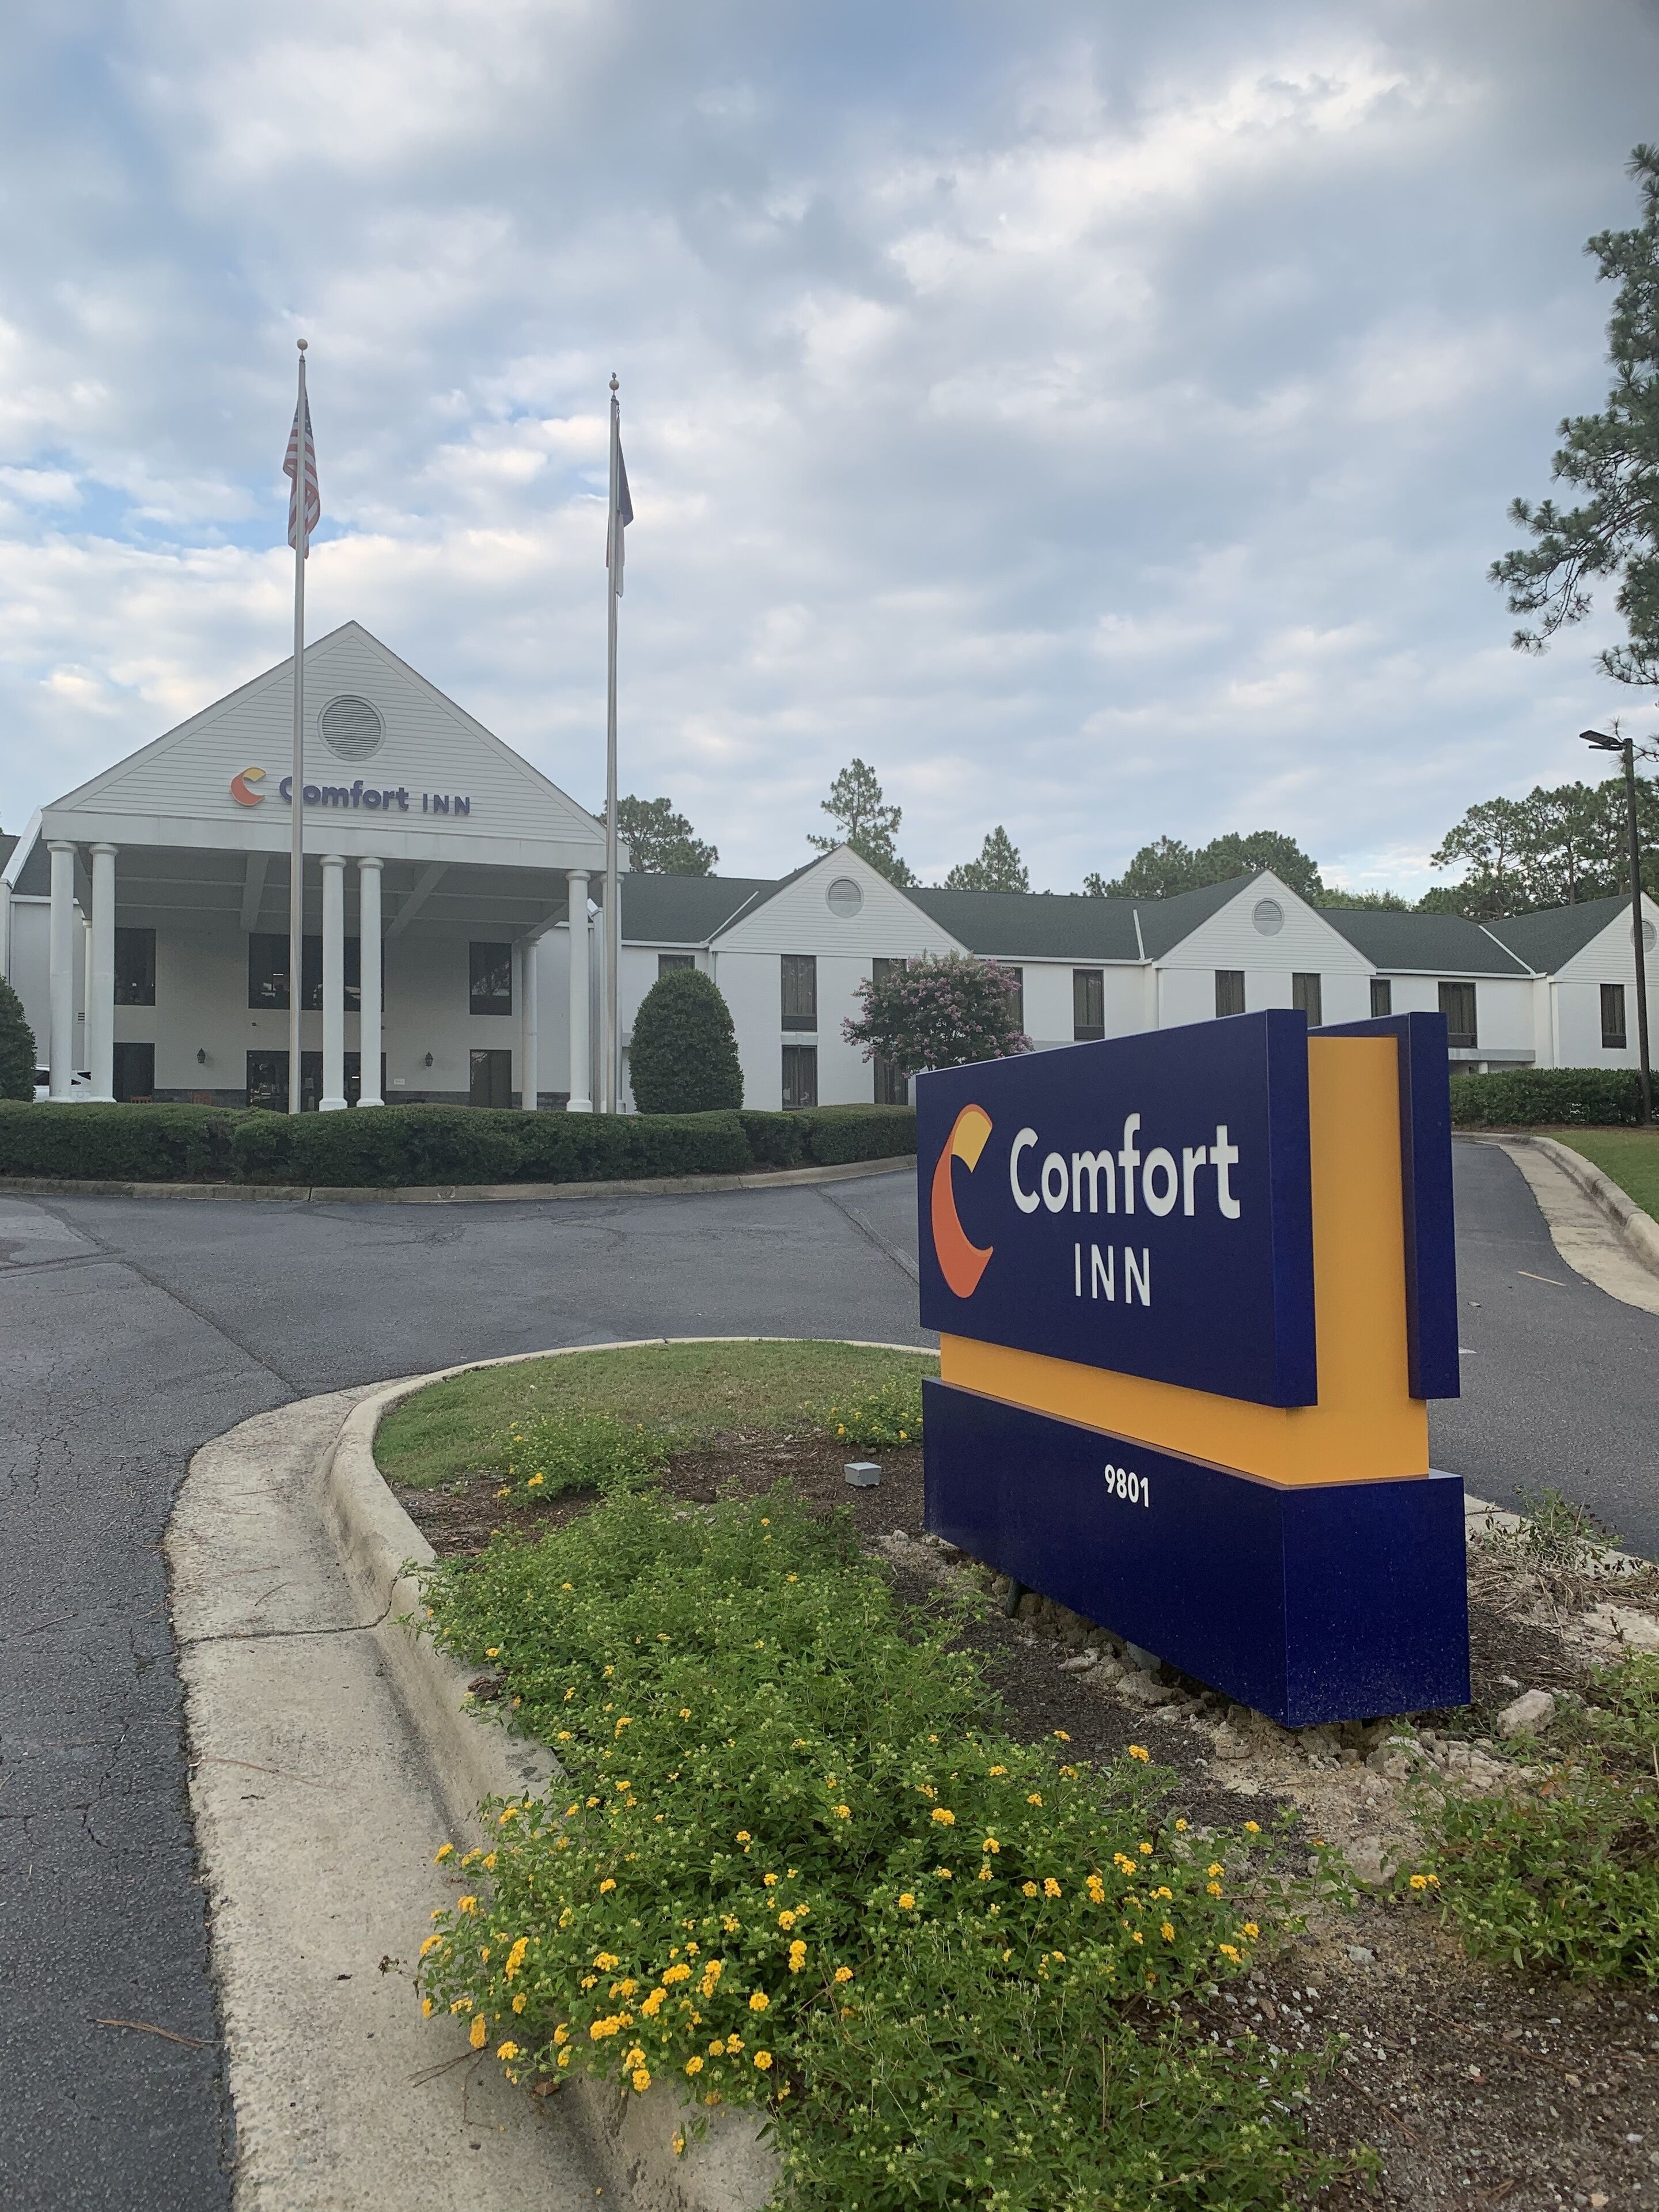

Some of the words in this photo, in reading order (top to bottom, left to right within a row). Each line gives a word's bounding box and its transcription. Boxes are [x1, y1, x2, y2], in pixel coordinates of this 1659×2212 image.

[279, 776, 409, 810] Comfort
[423, 793, 470, 814] INN
[1010, 1113, 1241, 1219] Comfort
[1074, 1243, 1150, 1306] INN
[1104, 1464, 1149, 1508] 9801
